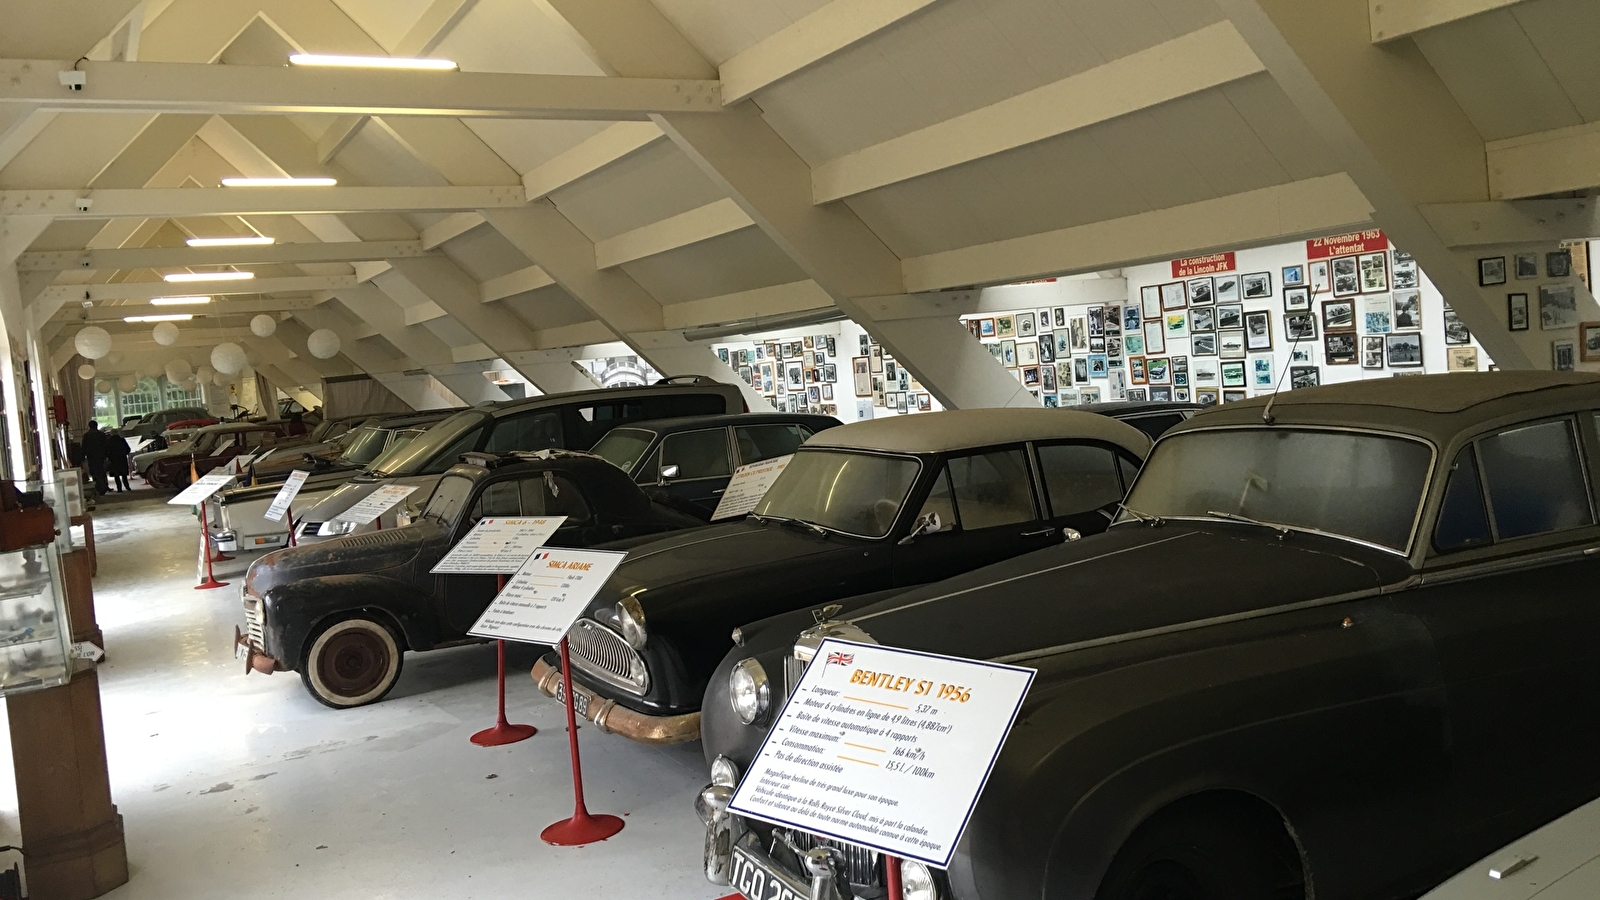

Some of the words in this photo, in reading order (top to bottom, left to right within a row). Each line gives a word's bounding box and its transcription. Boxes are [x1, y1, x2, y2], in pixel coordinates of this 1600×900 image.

[1314, 239, 1322, 247] 22
[1324, 233, 1360, 245] Novembre
[1362, 229, 1380, 240] 1963
[1329, 242, 1364, 256] L'attentat
[1178, 268, 1186, 276] de
[1187, 266, 1192, 275] la
[1194, 264, 1216, 274] Lincoln
[1216, 262, 1228, 272] JFK
[1188, 254, 1225, 265] construction
[547, 560, 567, 569] SIMCA
[566, 562, 594, 570] ARIANE
[850, 669, 915, 692] BENTLEY
[914, 680, 933, 696] S1
[937, 684, 971, 702] 1956
[804, 698, 824, 708] Moteur
[830, 704, 856, 714] cylindres
[865, 709, 881, 720] ligne
[881, 712, 890, 721] de
[891, 715, 902, 724] 4,9
[900, 716, 917, 726] litres
[812, 685, 840, 696] Longueur:
[915, 704, 931, 713] 5,37
[930, 707, 938, 715] m
[812, 714, 820, 722] de
[821, 717, 841, 727] vitesse
[841, 722, 878, 735] automatique
[879, 728, 885, 736] à
[886, 729, 891, 737] 4
[890, 732, 918, 742] rapports
[789, 725, 809, 736] Vitesse
[808, 731, 840, 743] maximum:
[893, 747, 906, 756] 166
[905, 749, 925, 760] km/h
[774, 750, 785, 759] Pas
[785, 753, 793, 761] de
[793, 755, 819, 767] direction
[819, 763, 843, 773] assistée
[782, 738, 825, 754] Consommation:
[886, 760, 900, 771] 15,5
[912, 766, 935, 778] 100km
[764, 768, 791, 780] Magnifique
[791, 774, 809, 784] berline
[842, 786, 854, 795] luxe
[878, 796, 898, 806] époque.
[750, 795, 768, 804] Confort
[773, 801, 790, 810] silence
[817, 813, 831, 821] toute
[831, 818, 848, 826] norme
[848, 822, 879, 834] automobile
[879, 830, 899, 839] connue
[919, 839, 941, 850] époque.
[774, 791, 797, 802] identique
[808, 799, 820, 808] Rolls
[820, 802, 836, 812] Royce
[836, 806, 851, 815] Silver
[852, 810, 869, 821] Cloud,
[896, 821, 903, 829] la
[903, 824, 928, 836] calandre.
